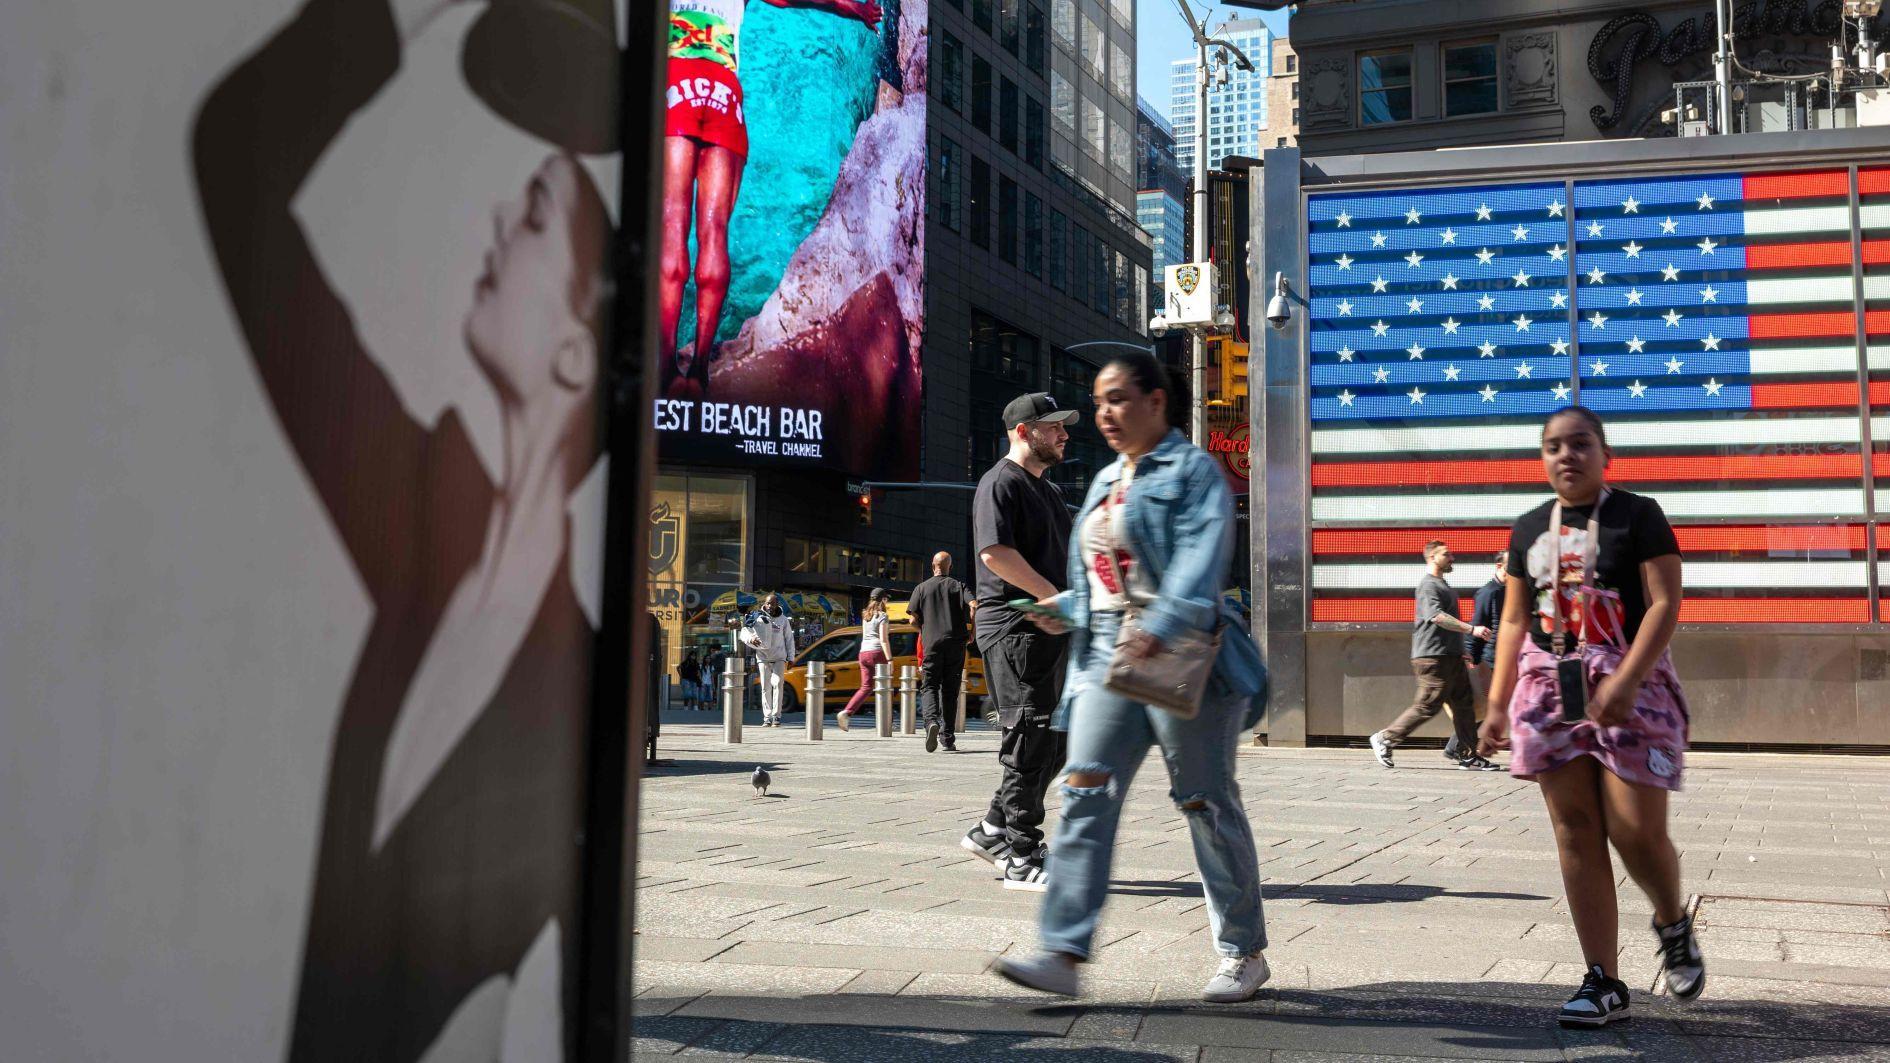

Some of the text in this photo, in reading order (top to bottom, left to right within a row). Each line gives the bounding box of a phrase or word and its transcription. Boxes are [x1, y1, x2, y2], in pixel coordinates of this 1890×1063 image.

[654, 399, 823, 440] EST BEACH BAR
[782, 442, 822, 458] CHANNEL
[1208, 431, 1250, 453] Hard
